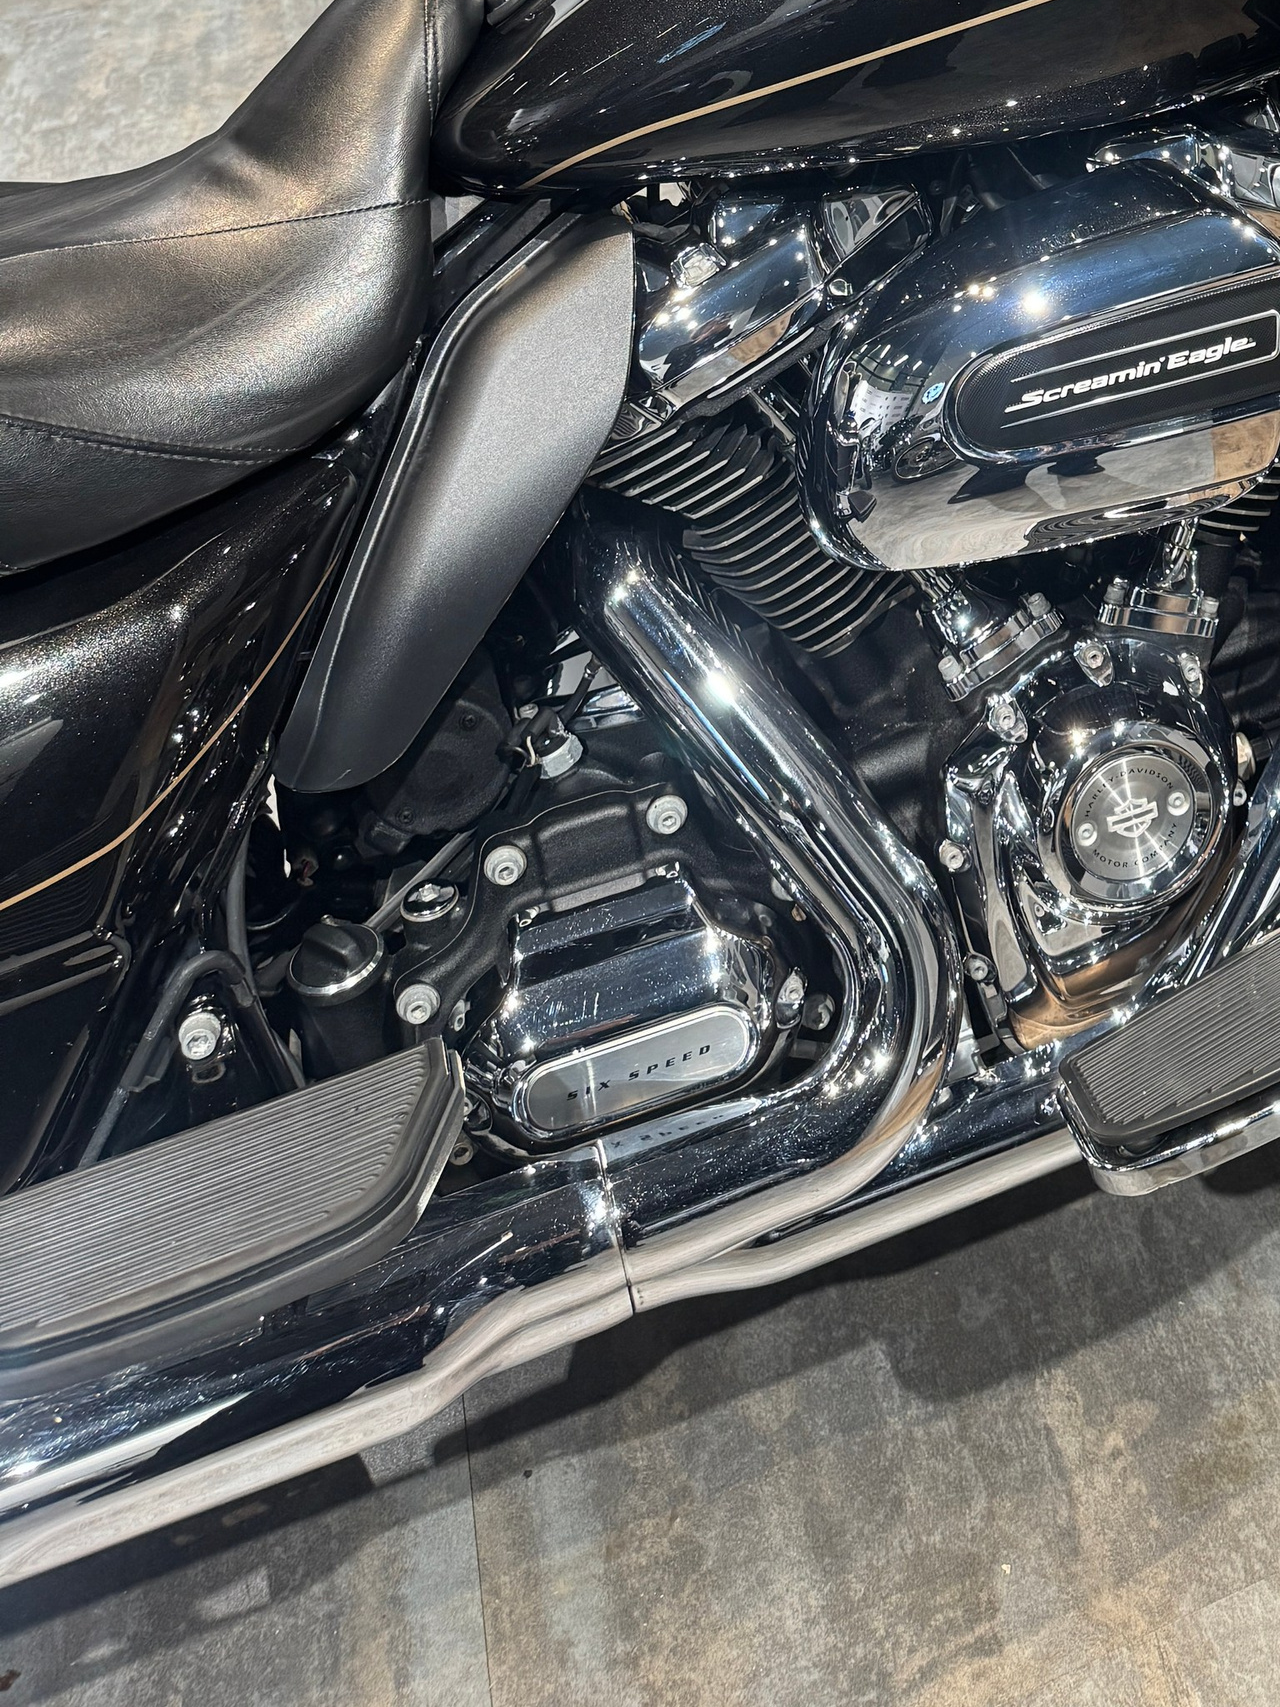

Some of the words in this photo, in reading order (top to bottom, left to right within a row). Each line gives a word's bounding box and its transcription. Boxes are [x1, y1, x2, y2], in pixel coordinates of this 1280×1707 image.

[1004, 356, 1166, 413] Screamin'
[1092, 847, 1129, 869] MOTOR
[566, 1079, 611, 1102] SIX
[628, 1044, 712, 1082] SPEED
